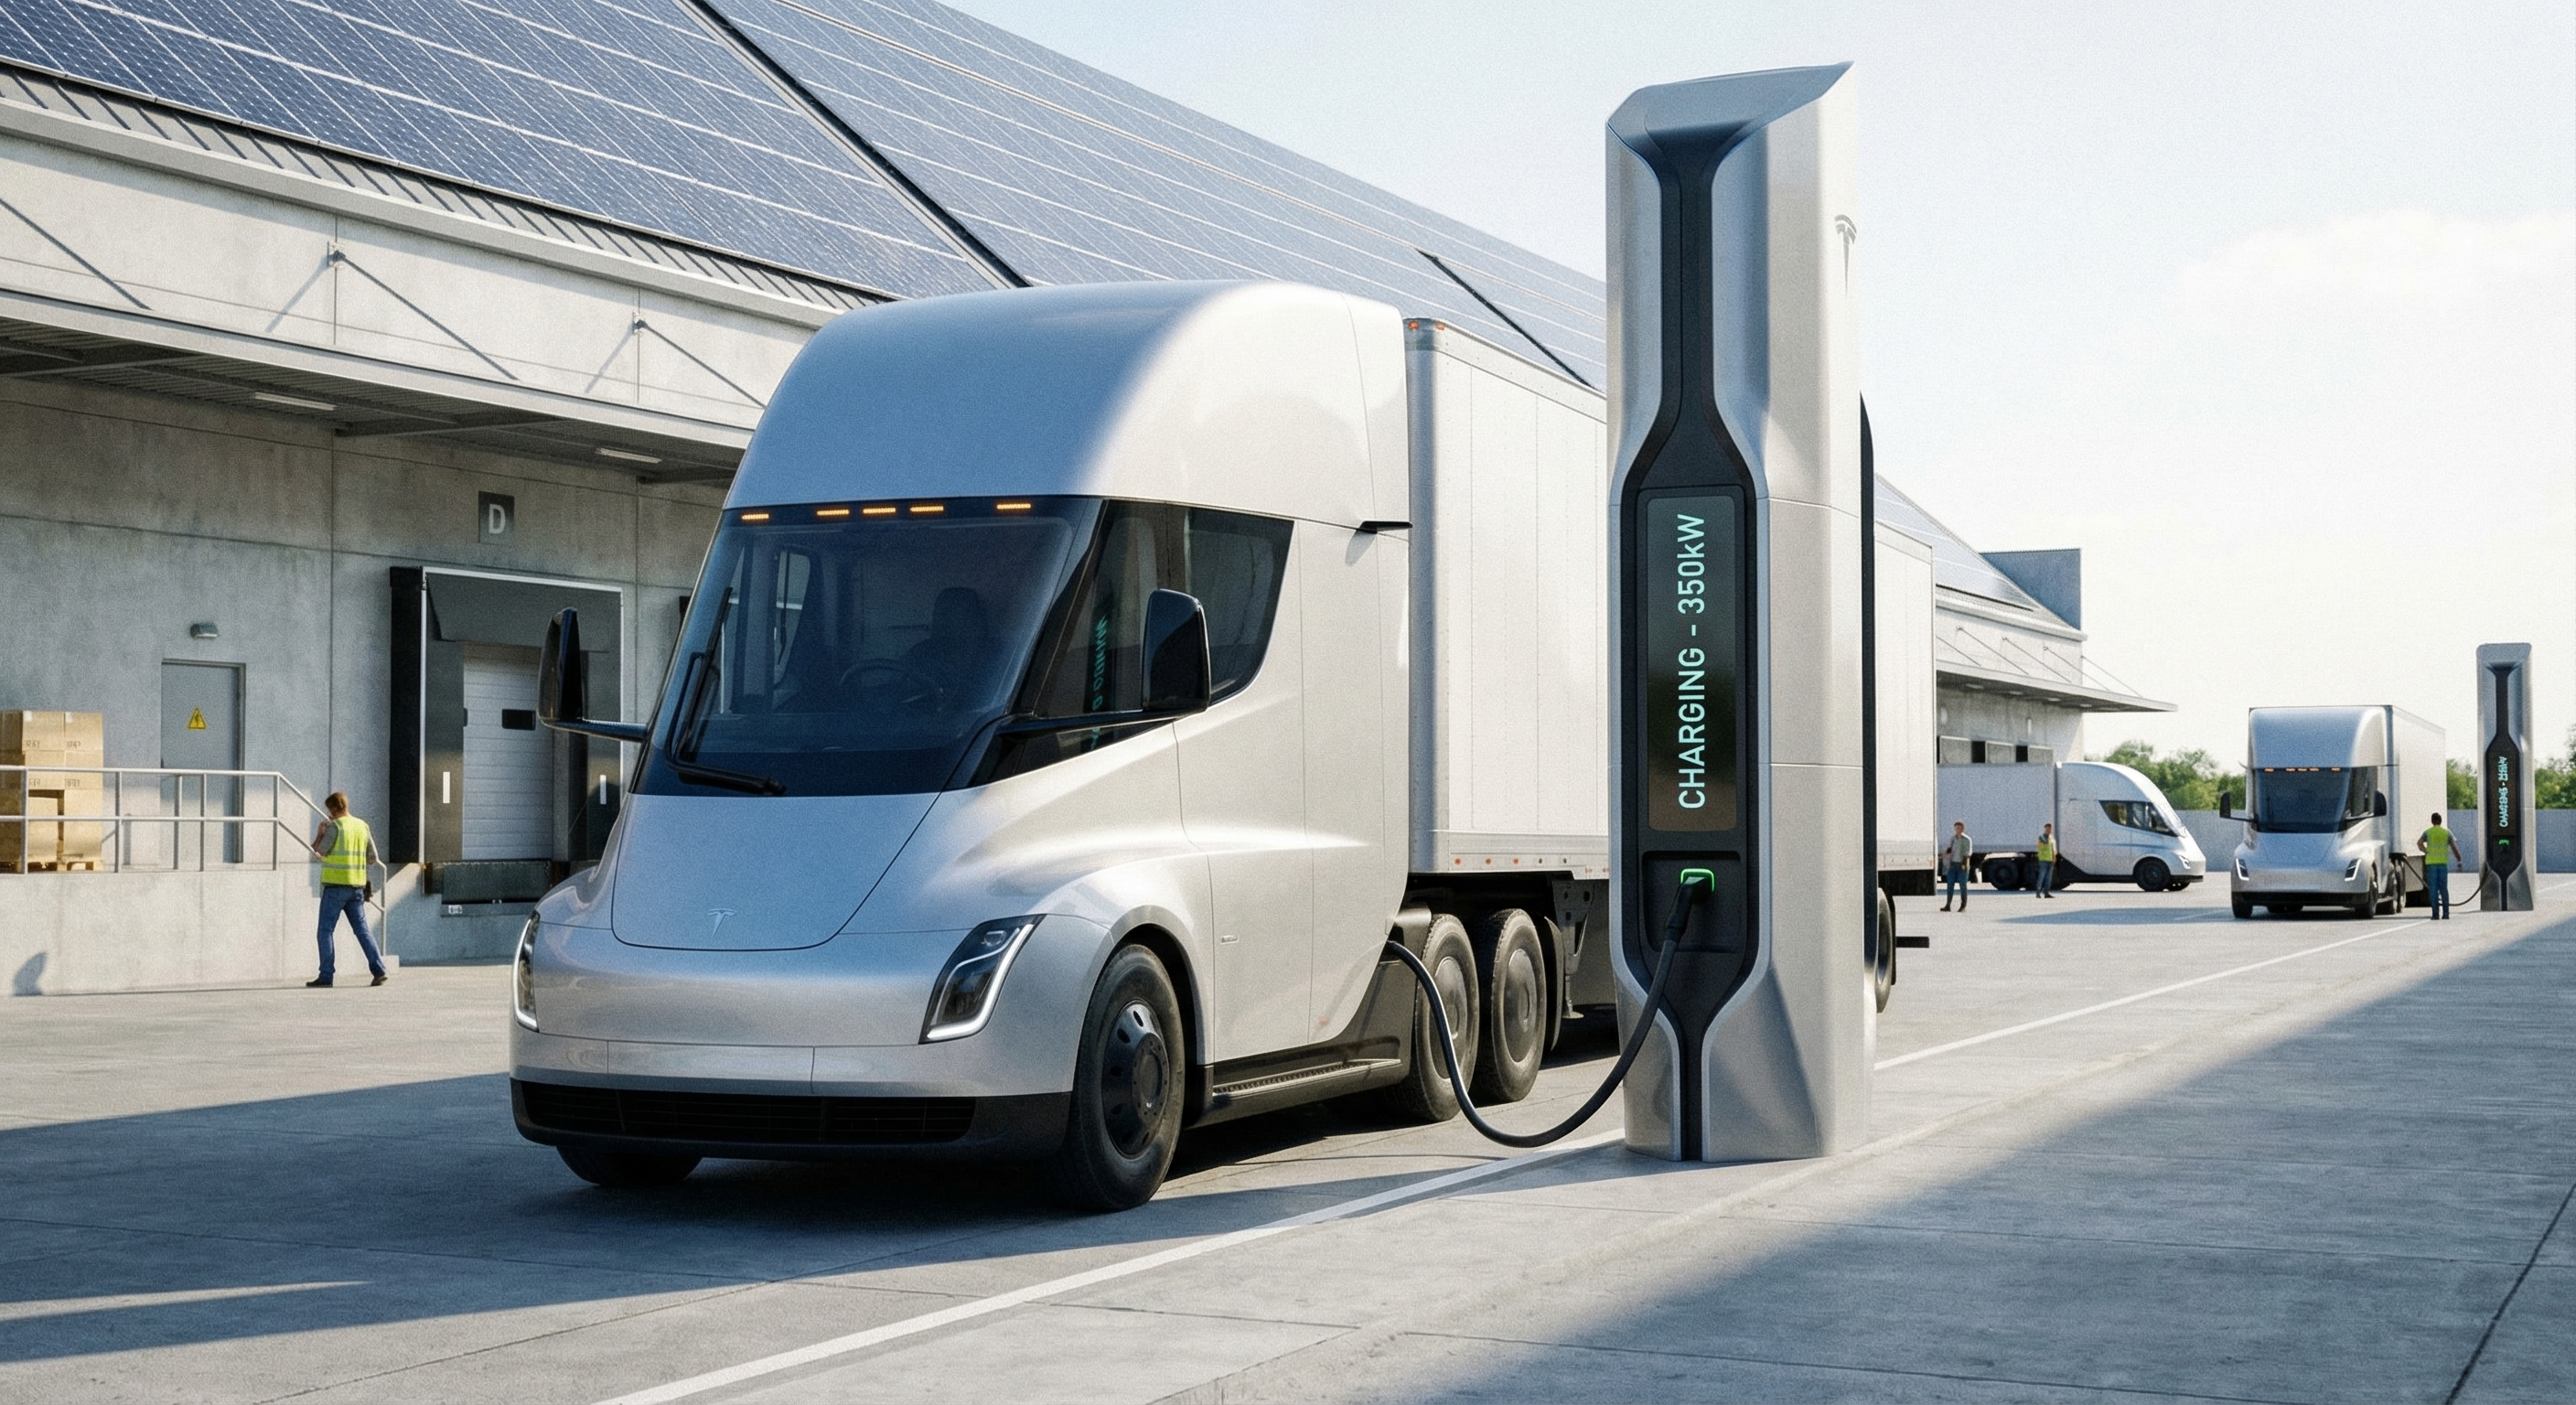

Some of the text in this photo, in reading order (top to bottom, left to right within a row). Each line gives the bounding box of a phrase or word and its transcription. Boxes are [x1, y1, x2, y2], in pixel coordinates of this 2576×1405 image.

[488, 503, 506, 534] D
[1677, 513, 1706, 615] 350kW
[1678, 648, 1706, 810] CHARGING
